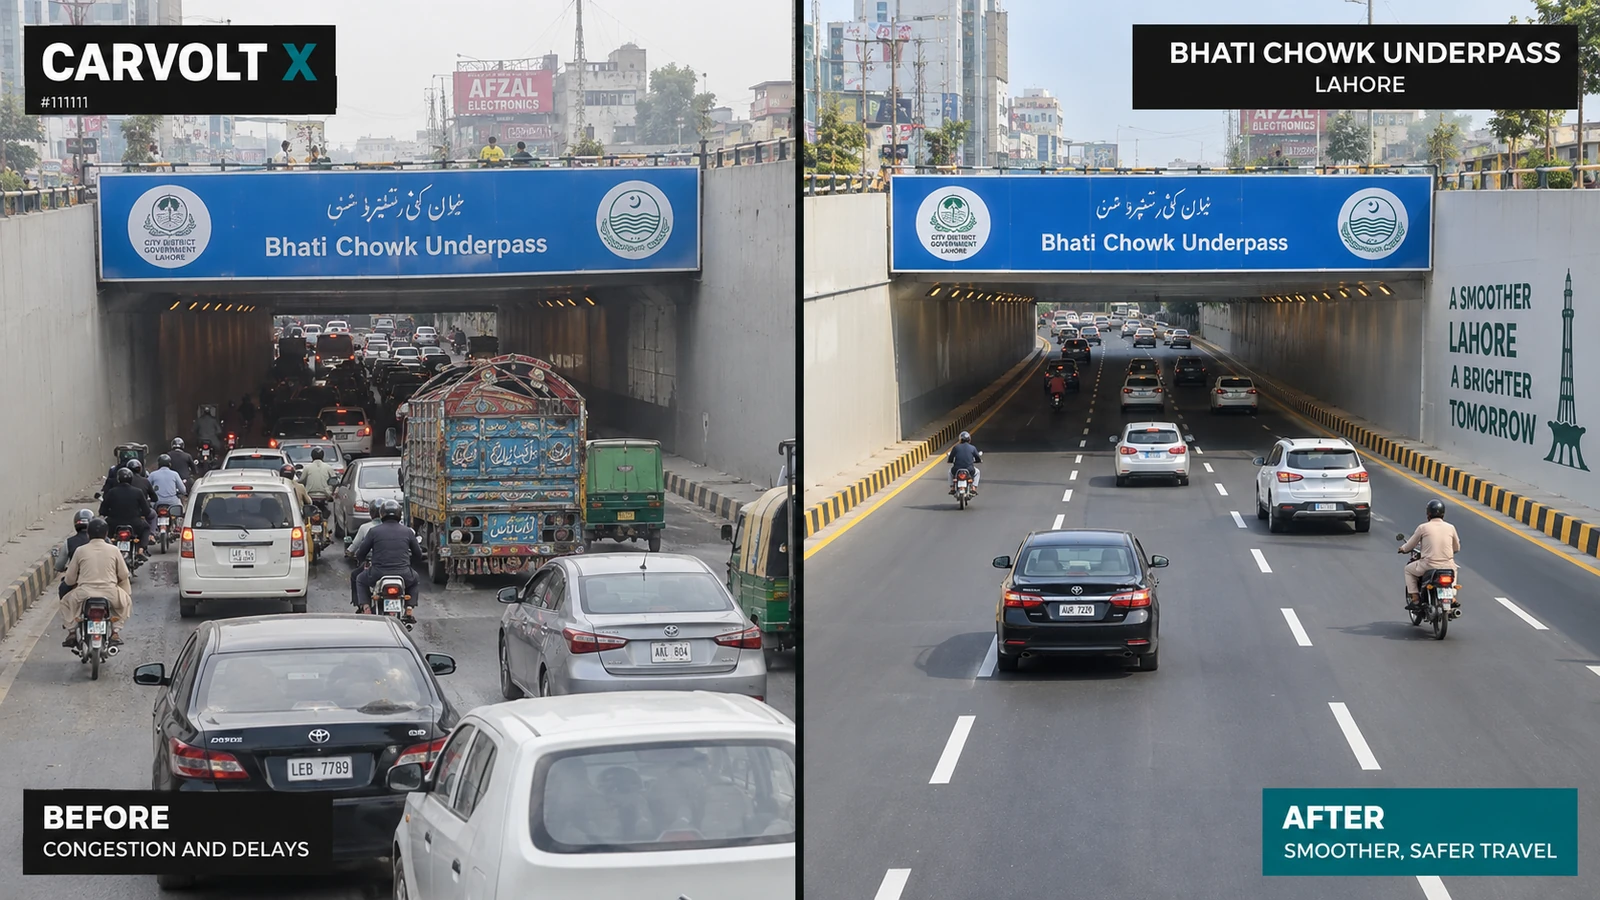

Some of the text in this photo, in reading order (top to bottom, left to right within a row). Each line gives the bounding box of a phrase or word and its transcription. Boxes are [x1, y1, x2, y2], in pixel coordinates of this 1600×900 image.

[469, 78, 538, 98] AFZAL
[468, 100, 539, 110] ELECTRONICS
[265, 234, 548, 259] Bhati Chowk Underpass
[1041, 233, 1289, 255] Bhati Chowk Underpass
[1449, 283, 1532, 310] A SMOOTHER
[1449, 321, 1517, 358] LAHORE
[1450, 365, 1532, 399] A BRIGHTER
[1449, 399, 1537, 445] TOMORROW
[291, 760, 349, 776] LEB 7789
